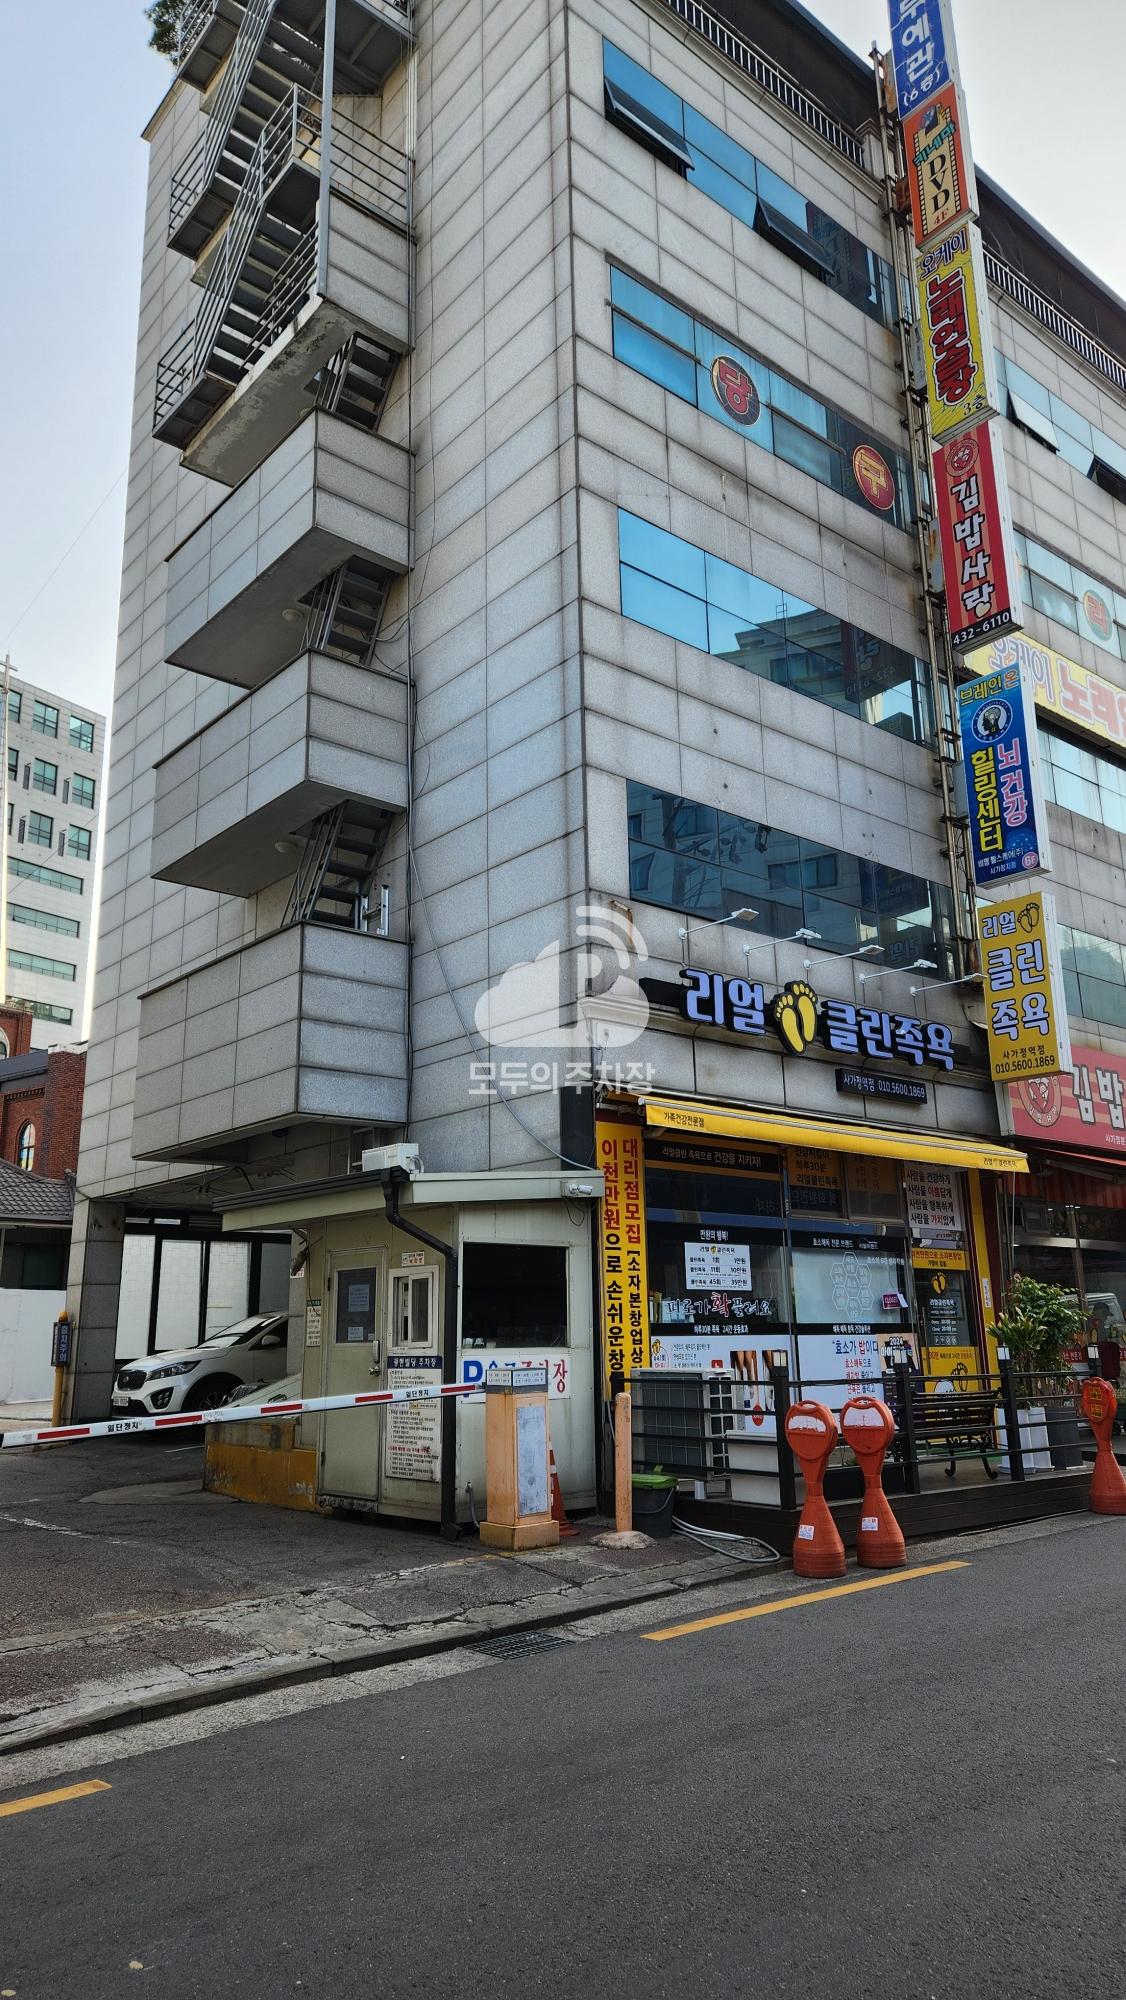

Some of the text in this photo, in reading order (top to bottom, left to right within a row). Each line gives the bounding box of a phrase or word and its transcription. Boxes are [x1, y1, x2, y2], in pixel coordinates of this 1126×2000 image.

[927, 153, 950, 215] DVD
[933, 207, 949, 225] 4F
[920, 230, 967, 278] 오케이
[927, 267, 977, 405] 노래연습장
[860, 449, 888, 499] 구
[950, 474, 995, 619] 김밥사랑
[953, 612, 1010, 645] 432-6110
[970, 746, 1003, 851] 힐링센터
[998, 738, 1028, 827] 뇌 건강
[1024, 855, 1036, 867] 6F
[981, 910, 1017, 939] 리얼
[986, 939, 1046, 993] 클린
[683, 968, 955, 1072] 리얼 클린족욕
[991, 992, 1051, 1041] 족욕
[995, 1054, 1056, 1075] 010.5600.1869
[1003, 1045, 1046, 1061] 사가정역점
[878, 1081, 925, 1098] 010.5600.1869
[714, 1151, 736, 1165] 건강을
[601, 1139, 622, 1274] 이천만원으로
[622, 1139, 640, 1245] 대리점모집
[908, 1184, 927, 1196] 사람을
[909, 1199, 928, 1211] 사람을
[911, 1213, 930, 1225] 사람을
[606, 1279, 624, 1347] 손쉬운
[889, 1336, 904, 1346] 2024
[405, 1389, 429, 1399] 일단정지
[107, 1423, 139, 1432] 일단정지
